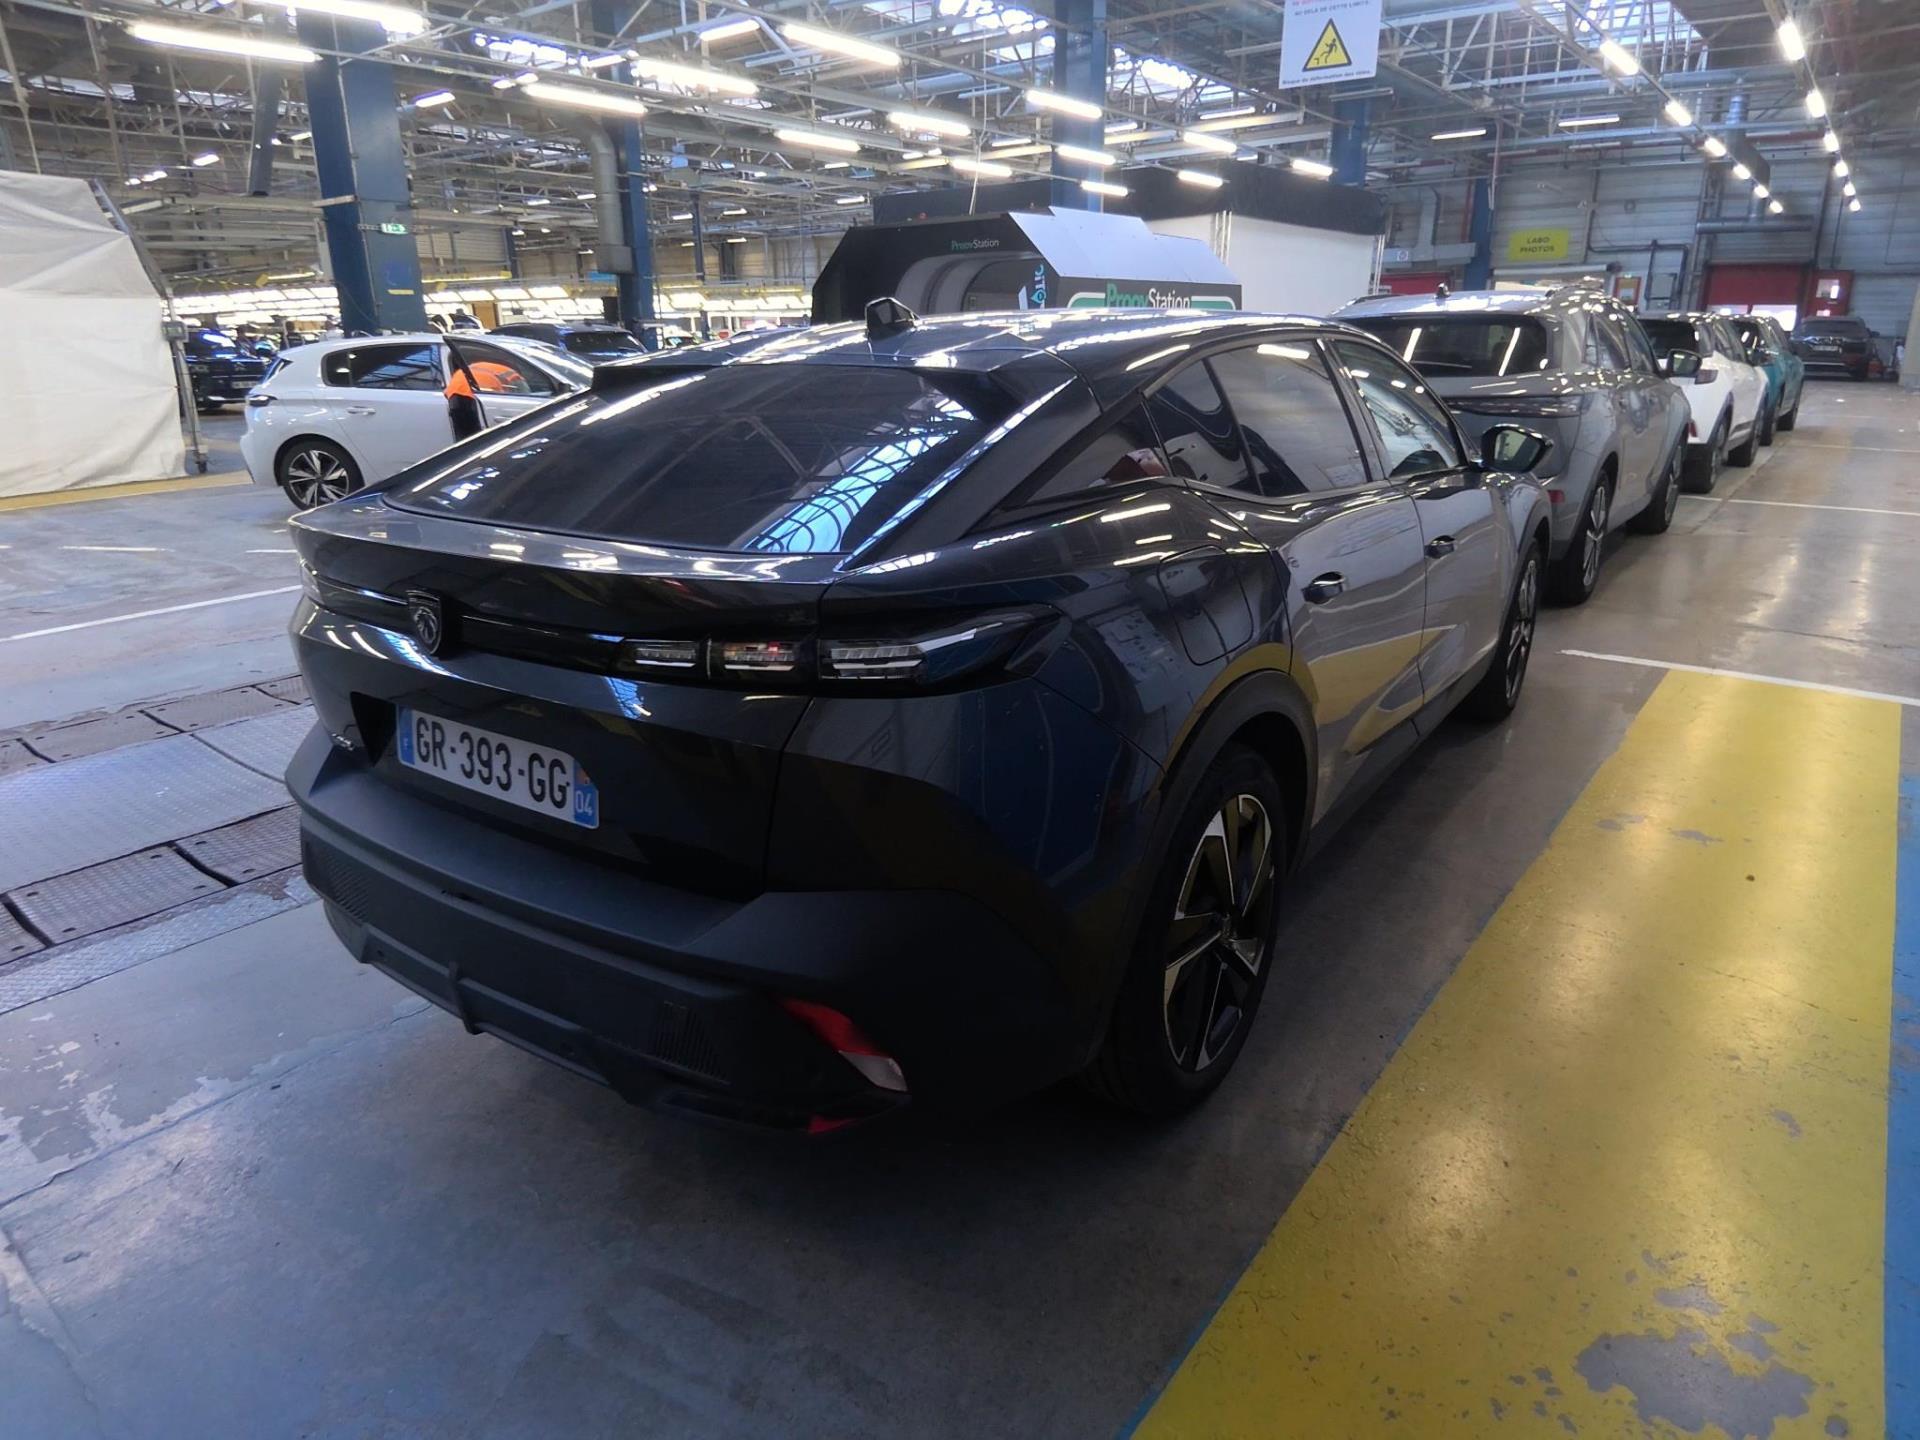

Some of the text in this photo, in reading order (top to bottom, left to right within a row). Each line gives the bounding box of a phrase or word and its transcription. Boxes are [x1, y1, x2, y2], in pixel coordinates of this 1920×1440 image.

[1527, 236, 1550, 244] LABO
[1520, 245, 1555, 253] PHOTOS
[416, 716, 570, 809] GR-393-GG
[575, 790, 593, 816] 04
